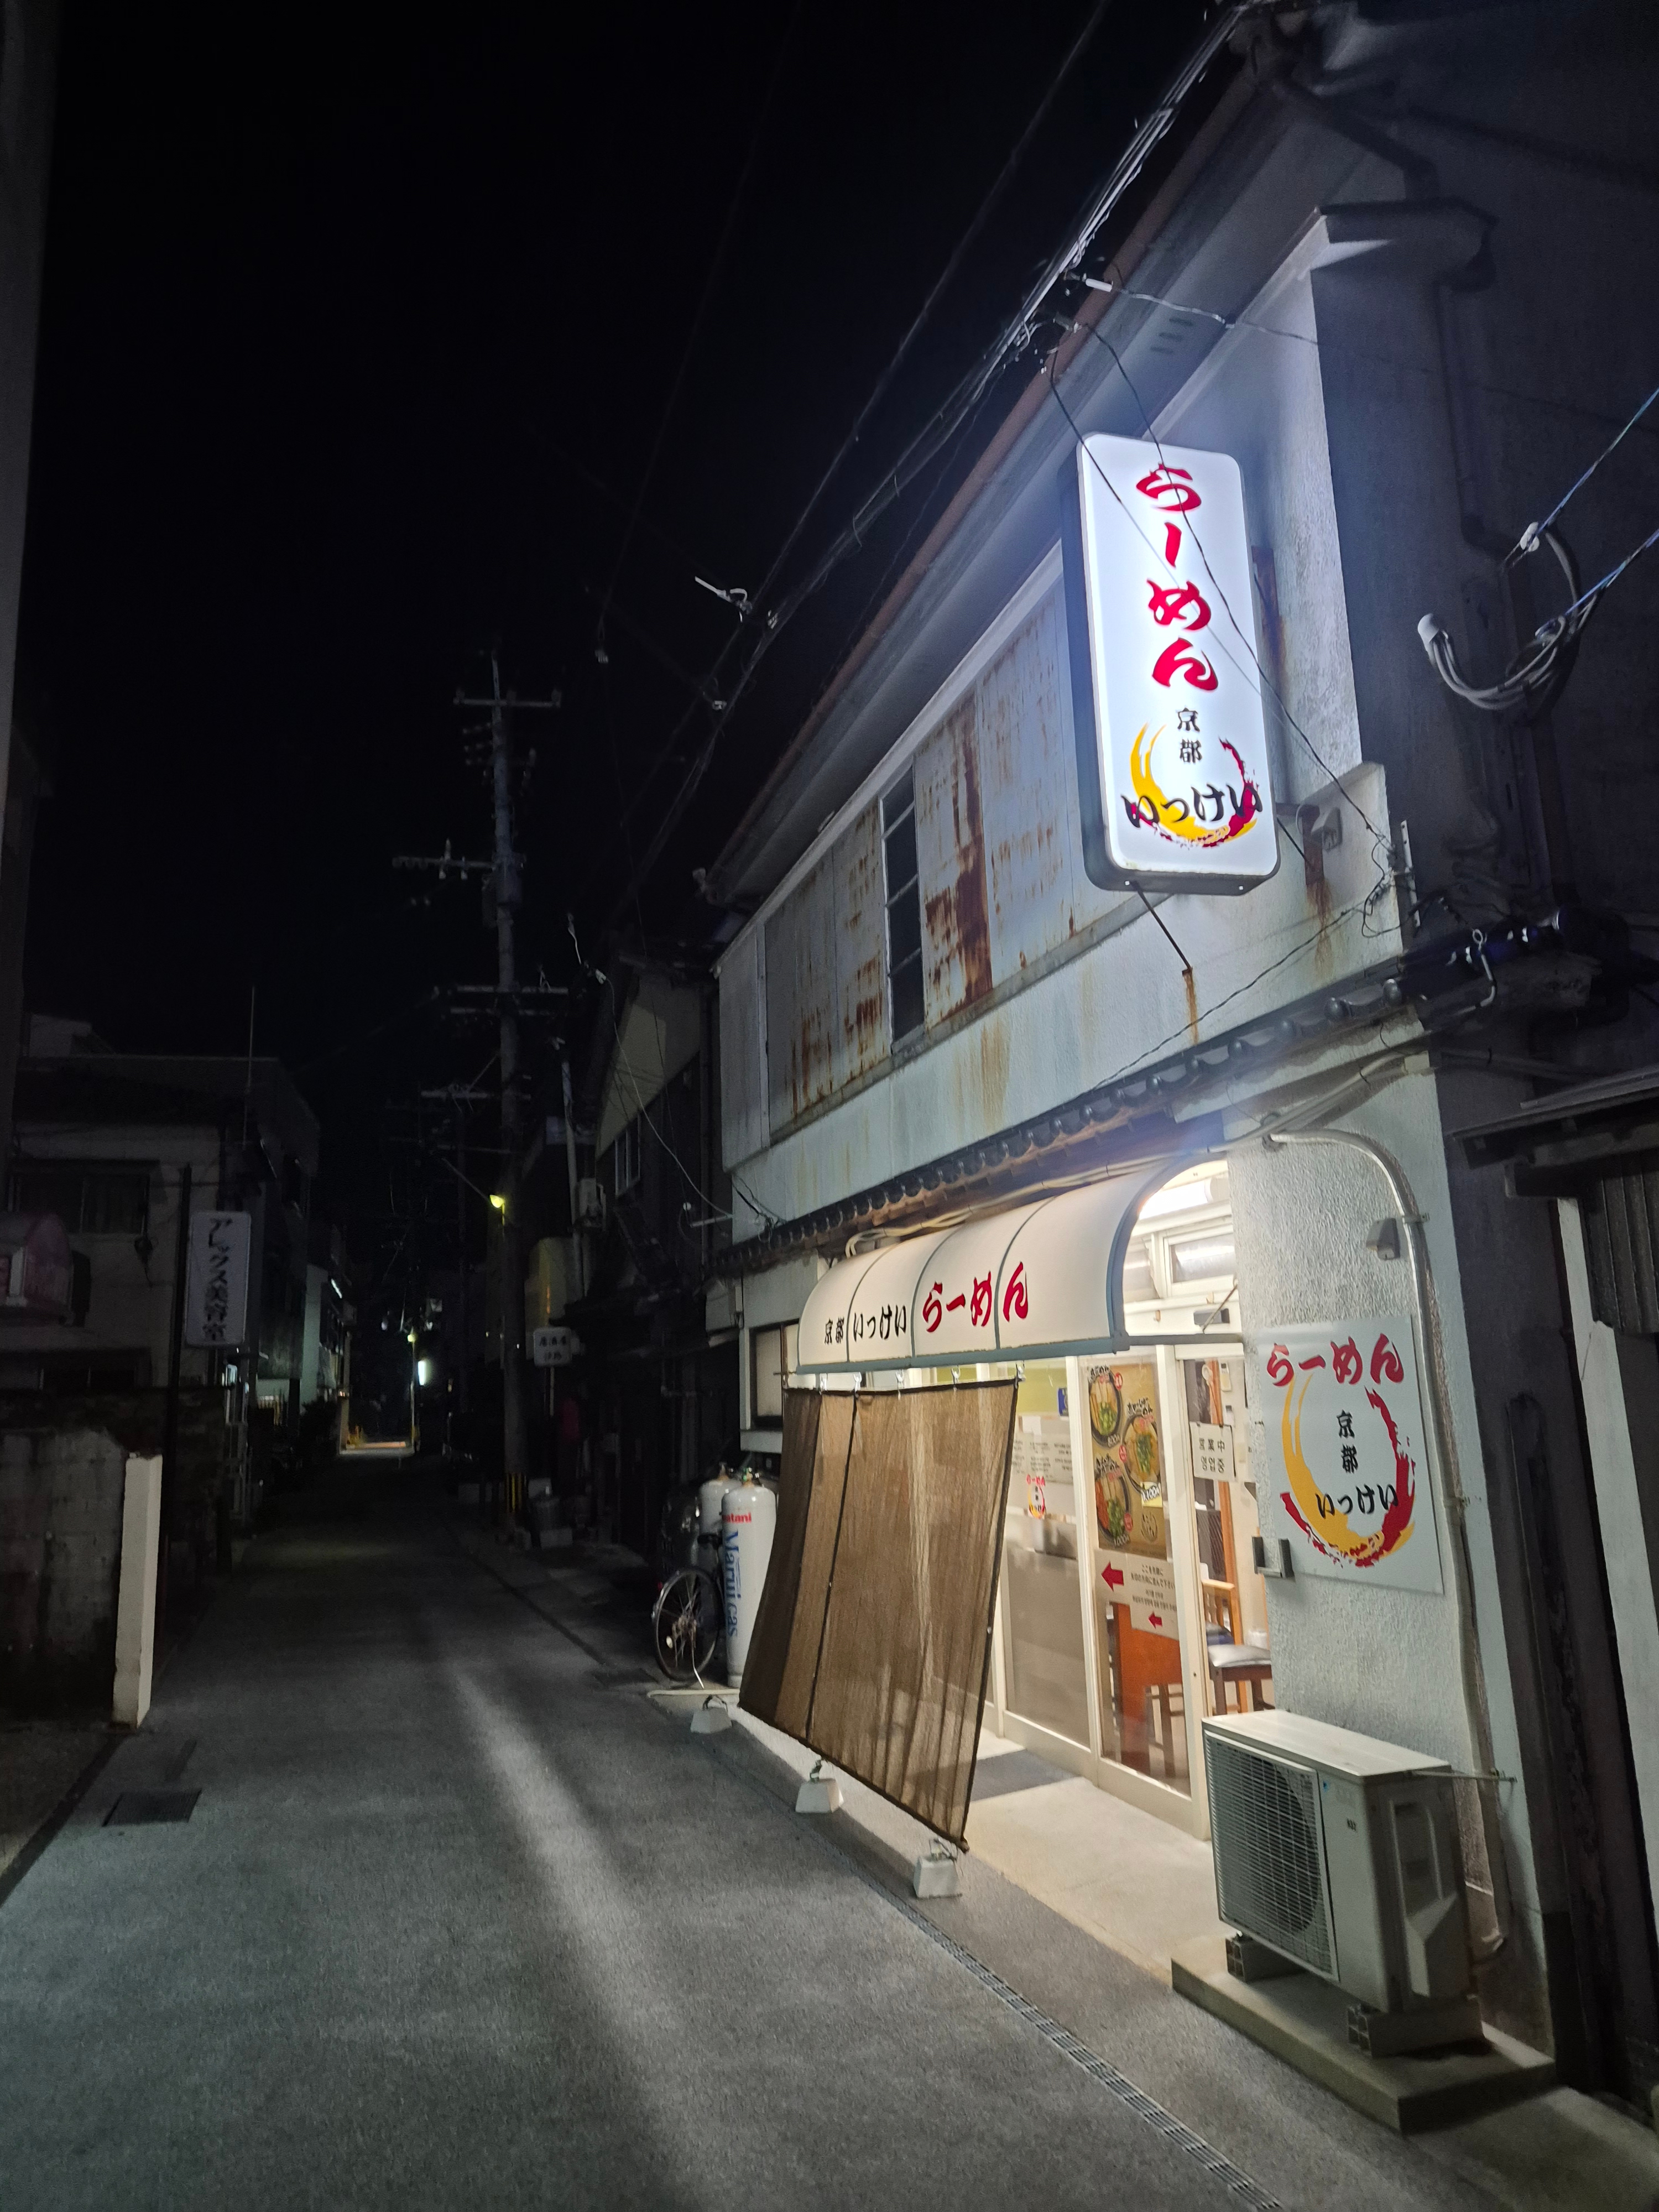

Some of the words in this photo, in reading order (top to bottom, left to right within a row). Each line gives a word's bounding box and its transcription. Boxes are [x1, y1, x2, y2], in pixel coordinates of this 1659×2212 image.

[1136, 462, 1218, 691] らーめん
[1176, 707, 1202, 763] 京都
[1120, 782, 1263, 828] いっけい
[825, 1317, 844, 1345] 京都
[853, 1303, 907, 1343] いっけい
[922, 1261, 1029, 1333] らーめん
[1267, 1333, 1405, 1386] らーめん
[1199, 1437, 1225, 1453] 営業中
[1201, 1455, 1225, 1474] 영업중
[1336, 1410, 1359, 1473] 京都
[1315, 1484, 1399, 1519] いっけい
